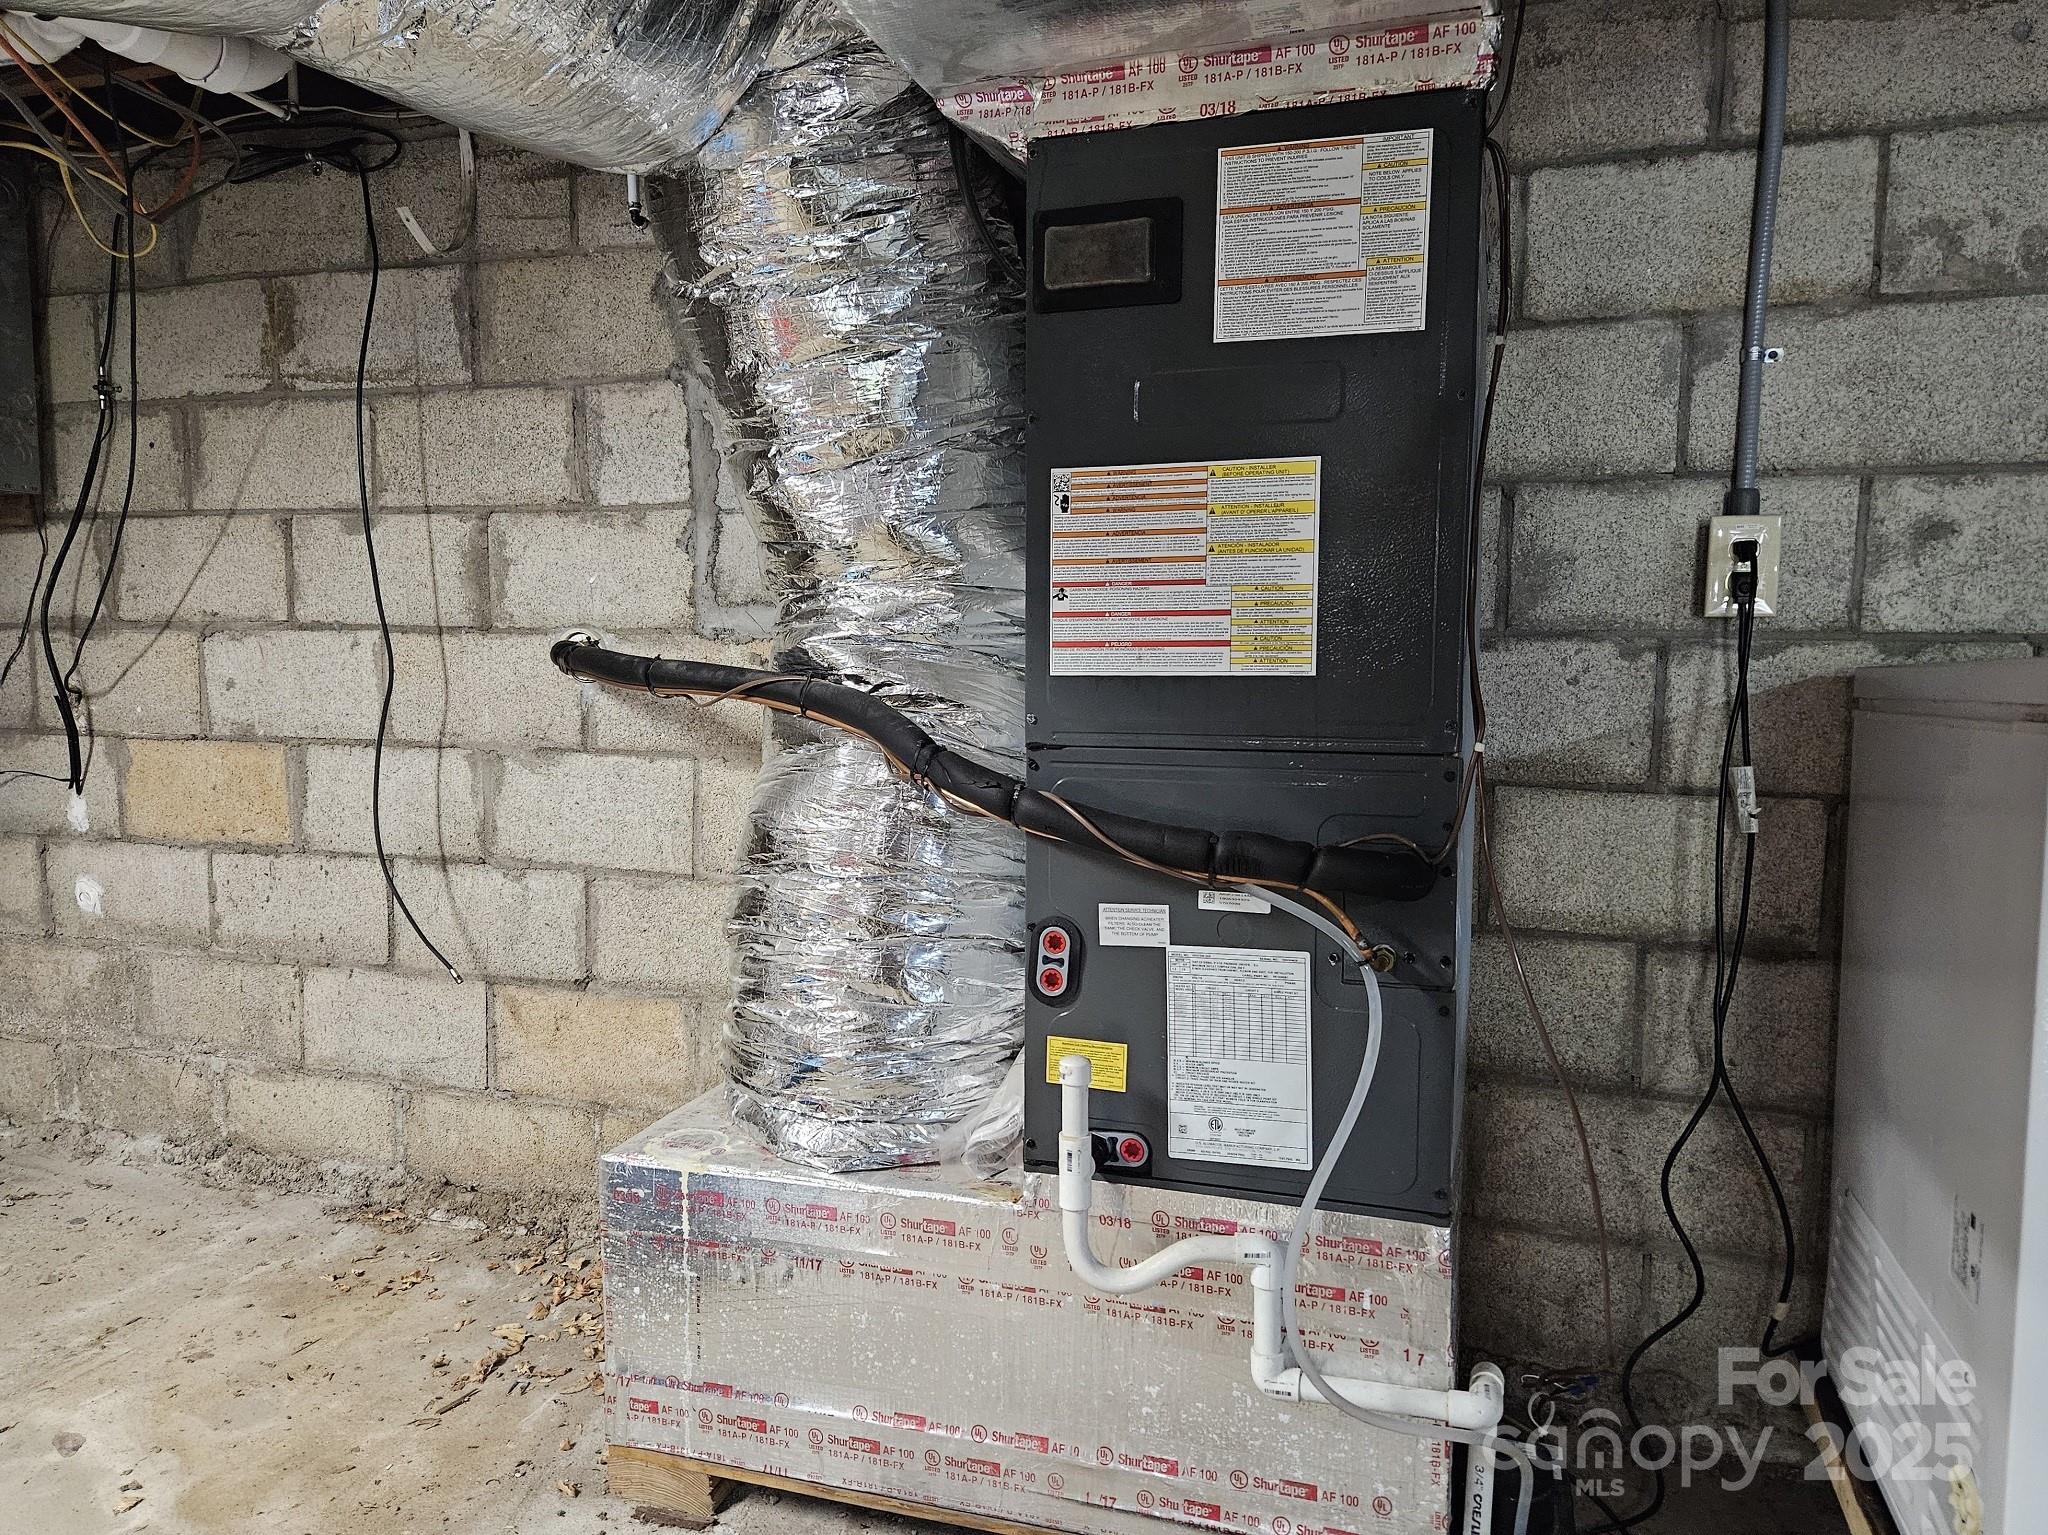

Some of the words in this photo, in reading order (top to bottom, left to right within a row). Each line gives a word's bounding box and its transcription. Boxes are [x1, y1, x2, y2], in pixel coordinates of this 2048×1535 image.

[1355, 31, 1414, 49] Shurtape
[1432, 25, 1450, 39] AF
[1455, 22, 1476, 35] 100
[1203, 51, 1259, 67] Shurtape
[1275, 47, 1292, 60] AF
[1295, 44, 1315, 57] 100
[1328, 56, 1349, 64] LISTED
[1356, 52, 1398, 66] 181A-P
[1410, 42, 1462, 59] 181B-FX
[1060, 69, 1114, 85] Shurtape
[1129, 65, 1142, 77] AF
[1149, 62, 1166, 74] 100
[1178, 74, 1198, 82] LISTED
[1204, 69, 1243, 84] 181A-P
[1254, 63, 1302, 77] 181B-FX
[976, 88, 1025, 103] Shurtape
[1062, 88, 1099, 100] 181A-P
[1110, 81, 1154, 96] 181B-FX
[956, 108, 973, 116] LISTED
[1200, 100, 1236, 117] 03/18
[727, 1198, 737, 1206] AF
[742, 1200, 755, 1209] 100
[783, 1204, 830, 1218] Shurtape
[840, 1212, 852, 1220] AF
[786, 1219, 815, 1230] 181A-P
[824, 1224, 861, 1235] 181B-FX
[900, 1218, 946, 1235] Shurtape
[959, 1226, 971, 1236] AF
[975, 1228, 991, 1239] 100
[1099, 1215, 1131, 1229] 03/18
[902, 1234, 933, 1244] 181A-P
[943, 1239, 981, 1251] 181B-FX
[1315, 1235, 1370, 1254] Shurtape
[1386, 1247, 1401, 1257] AF
[1406, 1250, 1426, 1262] 100
[707, 1251, 742, 1262] 181B-FX
[793, 1256, 822, 1272] 11/17
[1316, 1251, 1355, 1264] 181A-P
[1367, 1258, 1413, 1274] 181B-FX
[859, 1271, 891, 1283] 181A-P
[899, 1277, 938, 1289] 181B-FX
[1207, 1271, 1222, 1281] AF
[1227, 1273, 1243, 1285] 100
[980, 1289, 1012, 1300] 181A-P
[1022, 1295, 1062, 1308] 181B-FX
[1160, 1281, 1178, 1291] A-P
[1189, 1283, 1231, 1297] 181B-FX
[1295, 1285, 1333, 1298] urtape
[1349, 1290, 1364, 1302] AF
[1369, 1294, 1387, 1306] 100
[1083, 1303, 1100, 1311] LISTED
[1107, 1308, 1141, 1321] 181A-P
[1152, 1316, 1193, 1330] 181B-FX
[1217, 1324, 1235, 1332] LISTED
[1360, 1347, 1379, 1355] LISTED
[735, 1390, 747, 1399] AF
[661, 1406, 672, 1414] AF
[675, 1408, 689, 1417] 100
[647, 1417, 681, 1428] 181B-FX
[717, 1414, 758, 1431] Shurtape
[769, 1425, 781, 1434] AF
[784, 1428, 799, 1438] 100
[872, 1411, 916, 1428] Shurtape
[928, 1421, 942, 1433] AF
[718, 1428, 746, 1439] 181A-P
[755, 1435, 790, 1448] 181B-FX
[827, 1434, 871, 1453] Shurtape
[882, 1446, 895, 1455] AF
[899, 1449, 915, 1459] 100
[991, 1431, 1038, 1450] Shurtape
[1051, 1443, 1064, 1453] AF
[1069, 1444, 1080, 1457] 10
[828, 1449, 859, 1461] 181A-P
[868, 1457, 904, 1470] 181B-FX
[925, 1465, 941, 1473] LISTED
[944, 1456, 990, 1474] Shurtape
[1003, 1467, 1016, 1477] AF
[1020, 1469, 1036, 1482] 100
[1118, 1453, 1159, 1472] Shurtape
[1182, 1466, 1196, 1477] AF
[1200, 1470, 1217, 1482] 100
[1431, 1441, 1441, 1487] 181B-FX
[945, 1471, 977, 1485] 181A-P
[987, 1478, 1025, 1493] 181B-FX
[1474, 1465, 1484, 1492] 3/4"
[1253, 1477, 1307, 1497] Shurtape
[1322, 1491, 1336, 1501] AF
[1340, 1493, 1359, 1507] 100
[1159, 1497, 1212, 1517] Shutape
[1224, 1511, 1238, 1522] AF
[1242, 1514, 1260, 1527] 100
